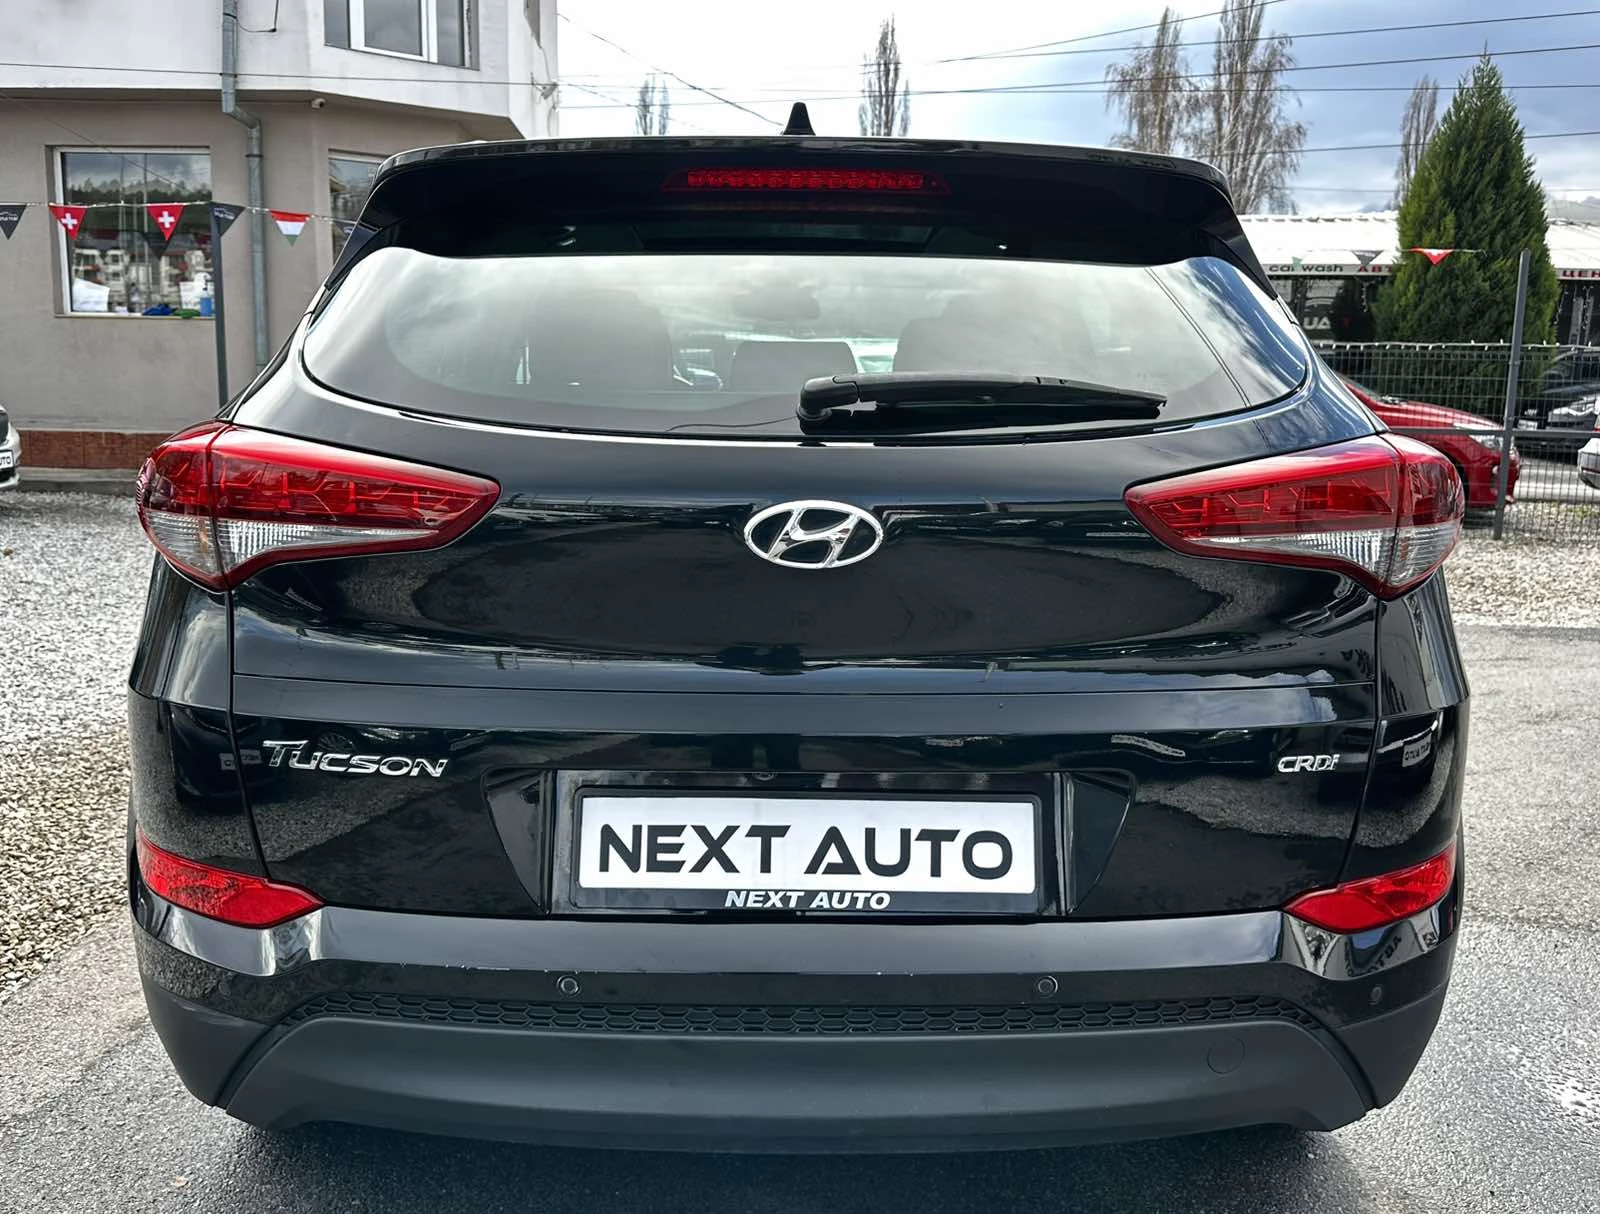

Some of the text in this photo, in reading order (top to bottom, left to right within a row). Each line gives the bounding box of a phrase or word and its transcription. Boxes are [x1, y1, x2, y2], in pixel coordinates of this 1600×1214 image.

[1302, 263, 1344, 272] wash
[262, 739, 449, 778] TUCSON
[1277, 753, 1340, 773] CRDi
[598, 823, 1014, 881] NEXT AUTO
[724, 889, 891, 910] NEXT AUTO
